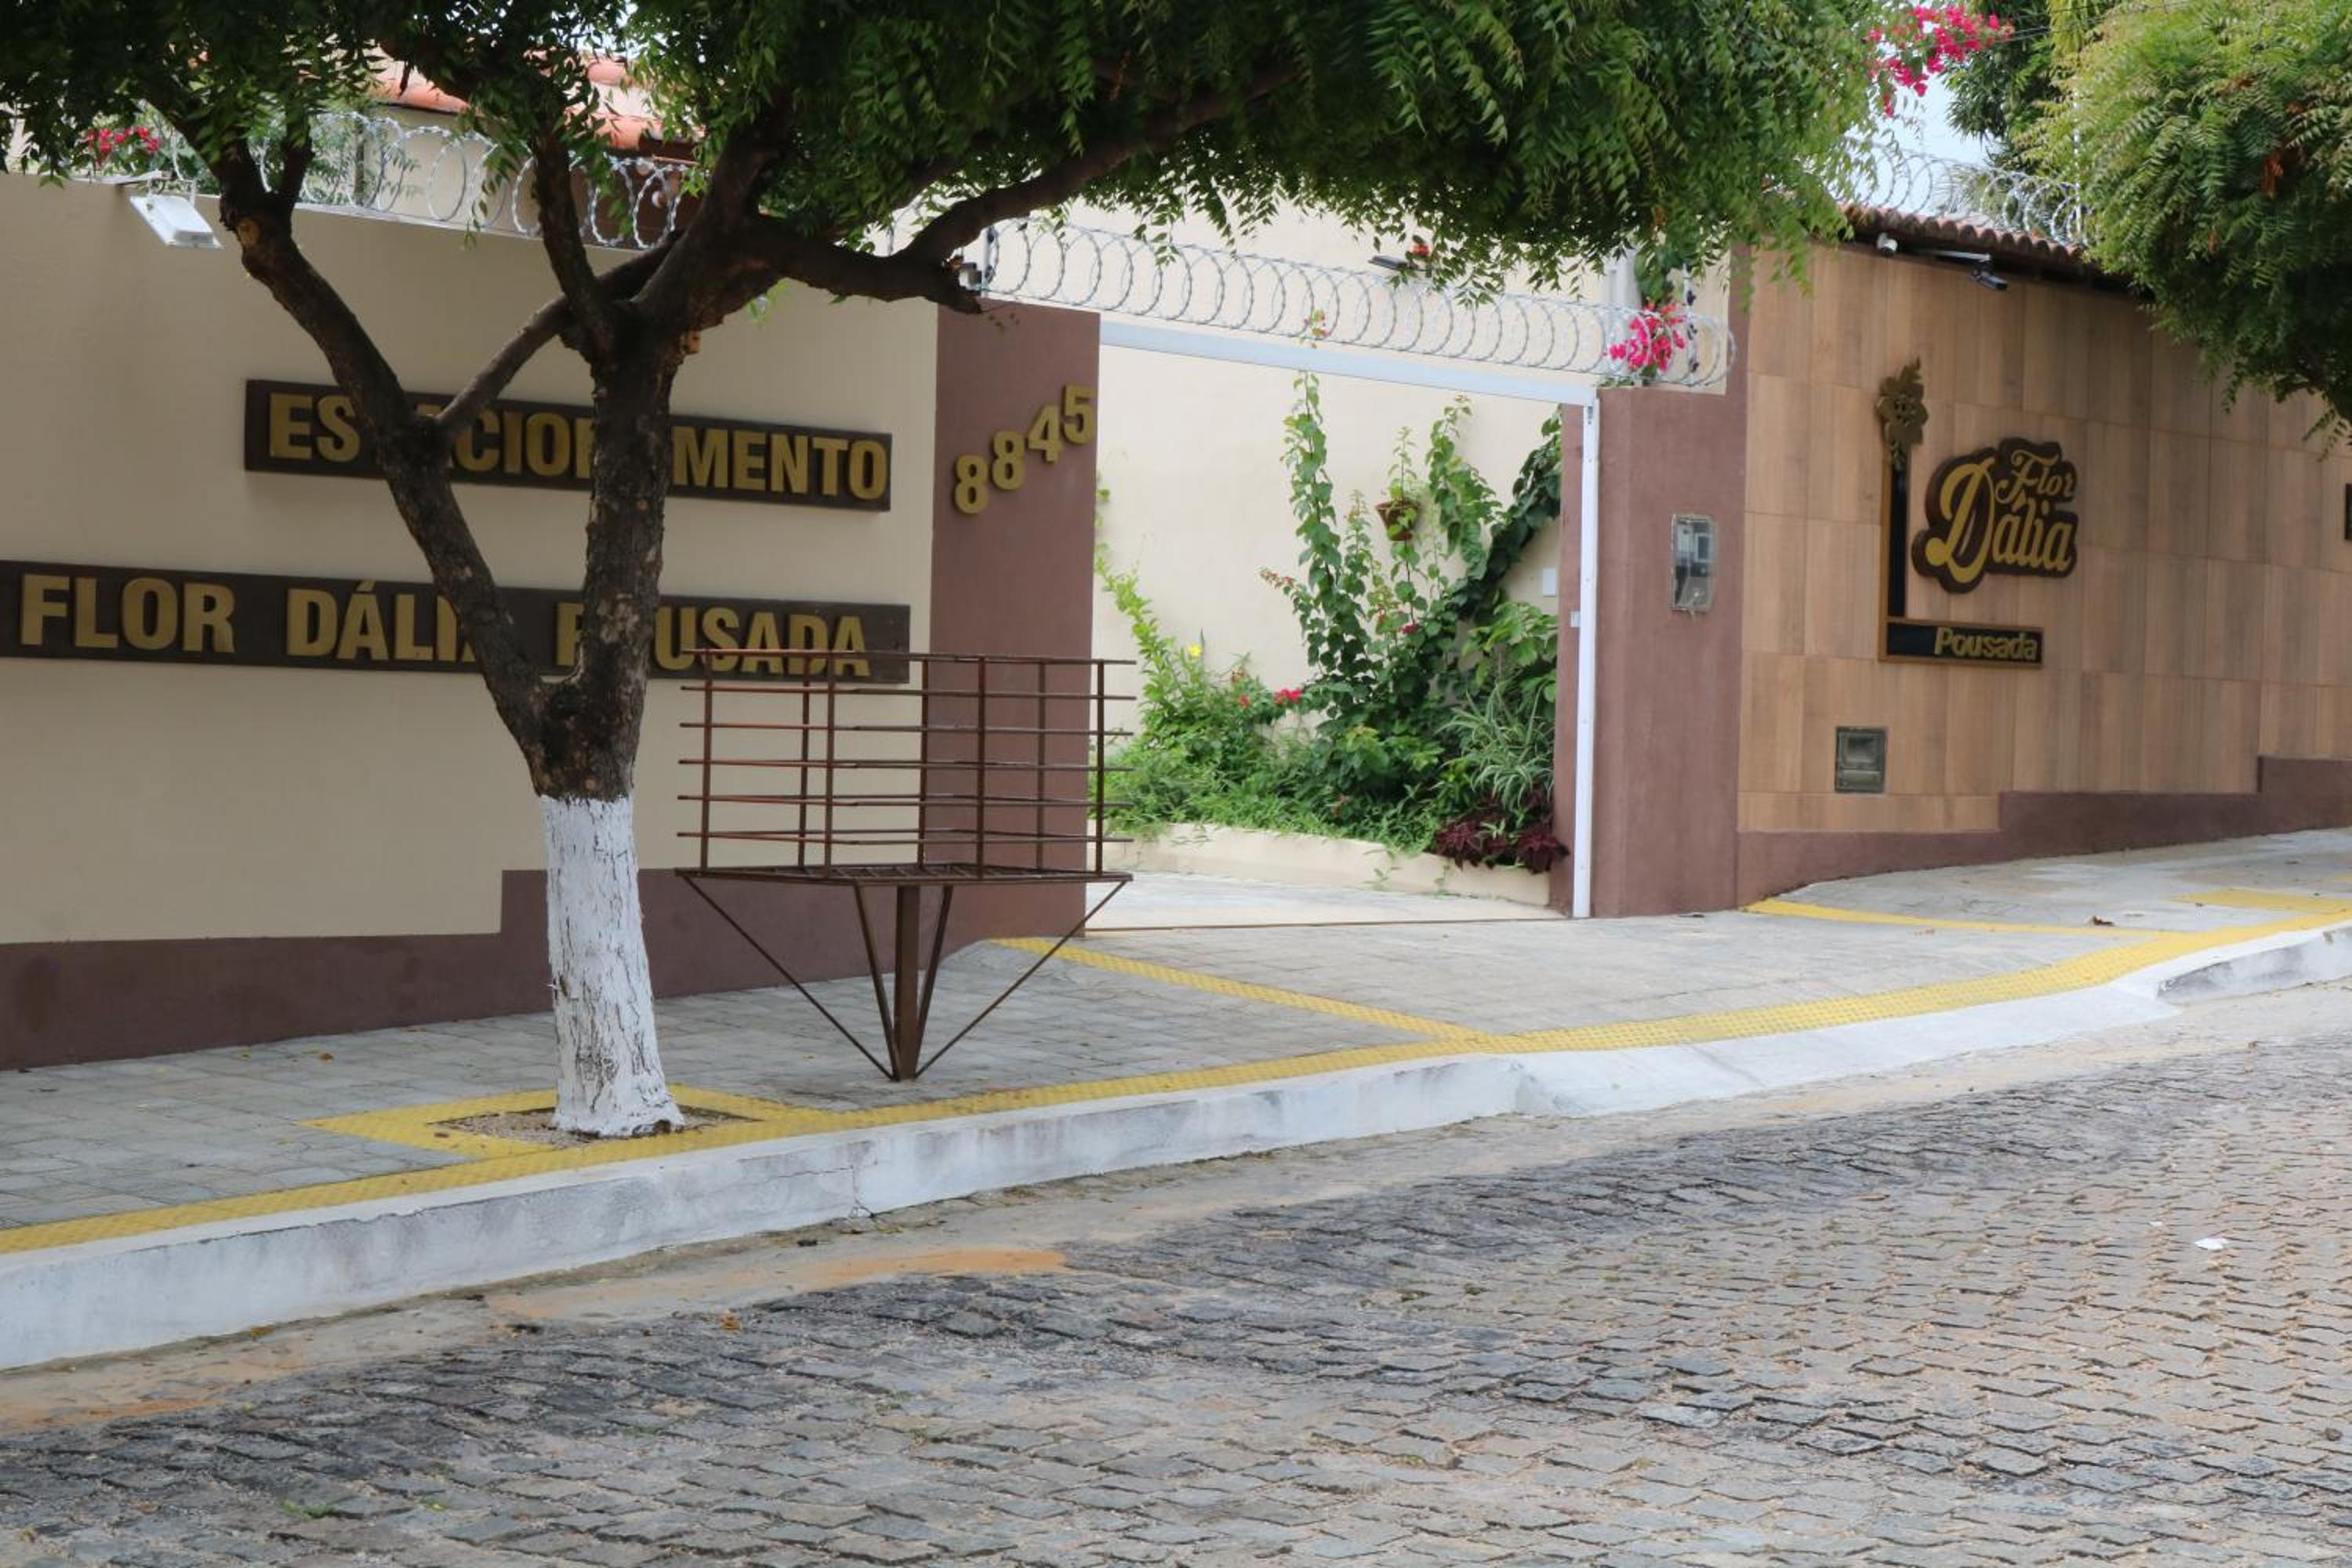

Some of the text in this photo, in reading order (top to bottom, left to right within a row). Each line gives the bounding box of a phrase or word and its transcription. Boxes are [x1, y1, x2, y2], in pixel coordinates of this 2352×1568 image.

[269, 391, 887, 501] ESCIOMENTO
[953, 381, 1097, 514] 8845
[1995, 449, 2074, 504] Flor
[20, 572, 235, 654] FLOR
[555, 601, 871, 677] PUSADA
[1934, 626, 2038, 661] Pousada
